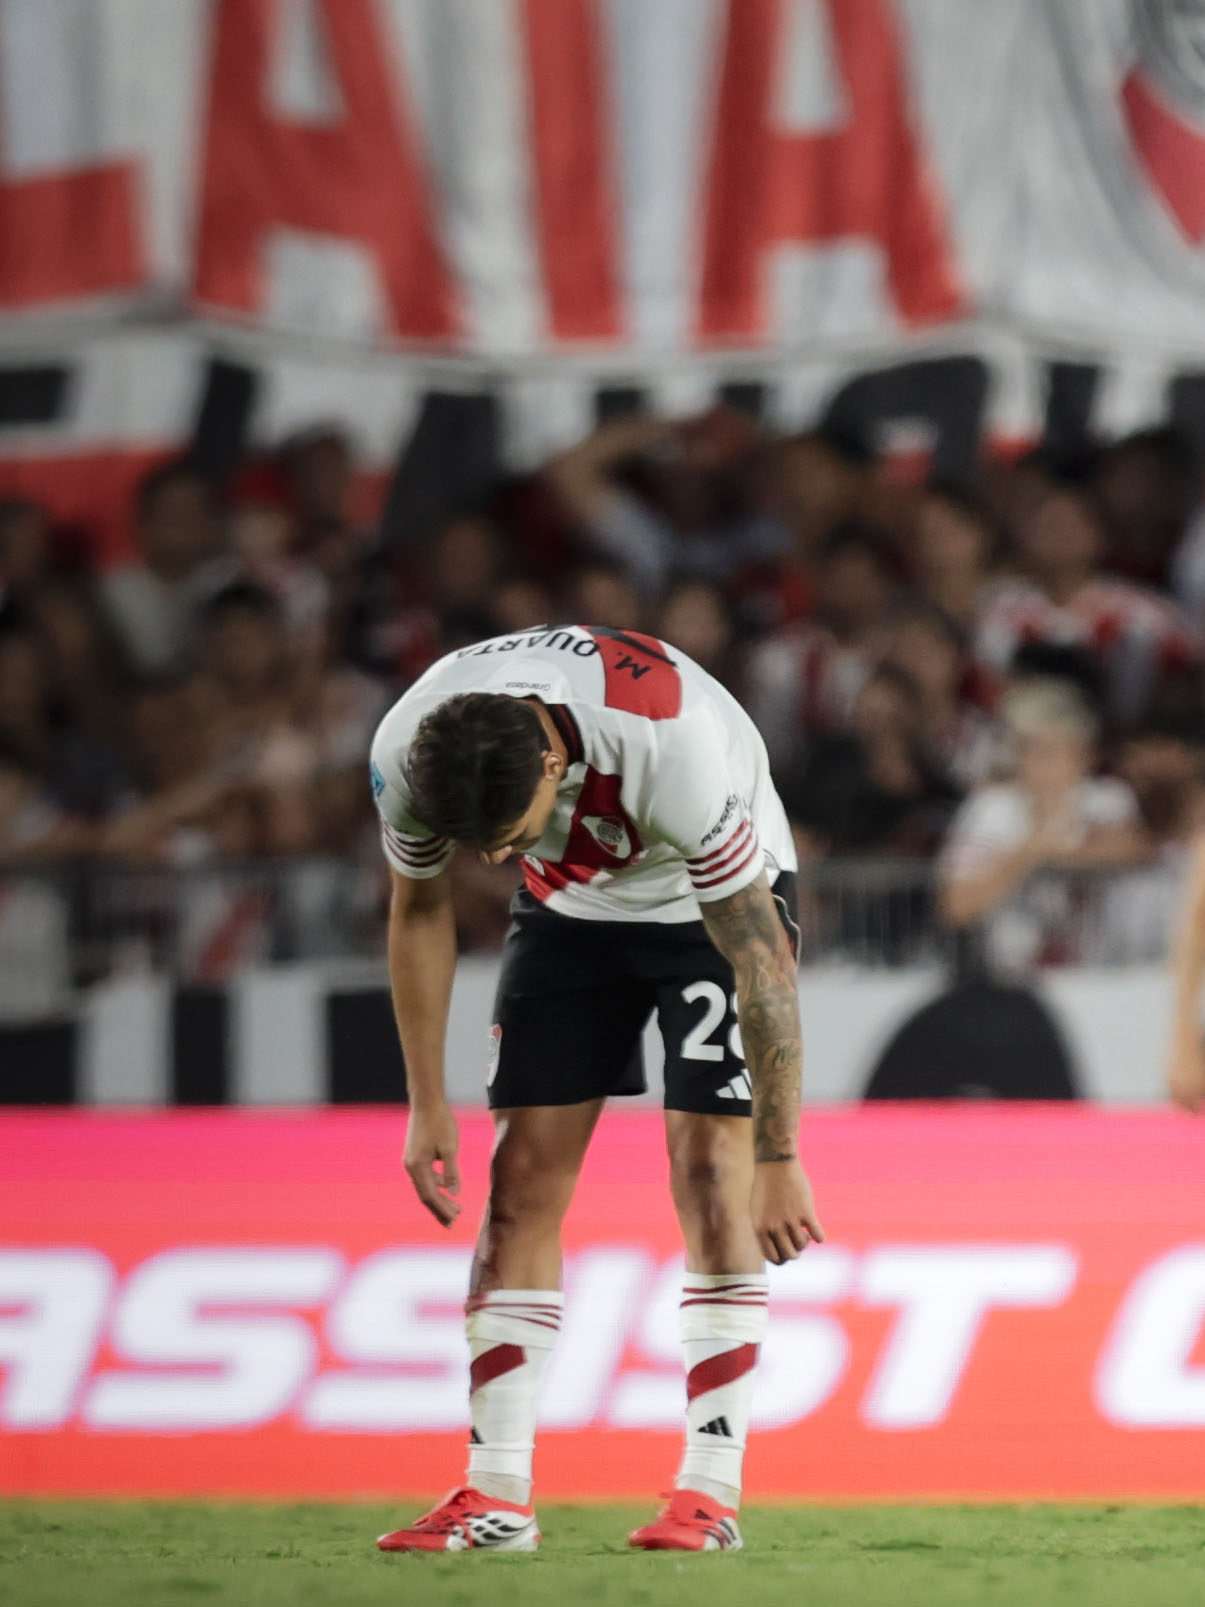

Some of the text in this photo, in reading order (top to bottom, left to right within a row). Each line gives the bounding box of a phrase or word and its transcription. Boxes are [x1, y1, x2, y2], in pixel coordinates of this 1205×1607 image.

[457, 630, 601, 657] QUARTA
[614, 651, 652, 680] M.
[0, 1245, 1079, 1433] ASSIST
